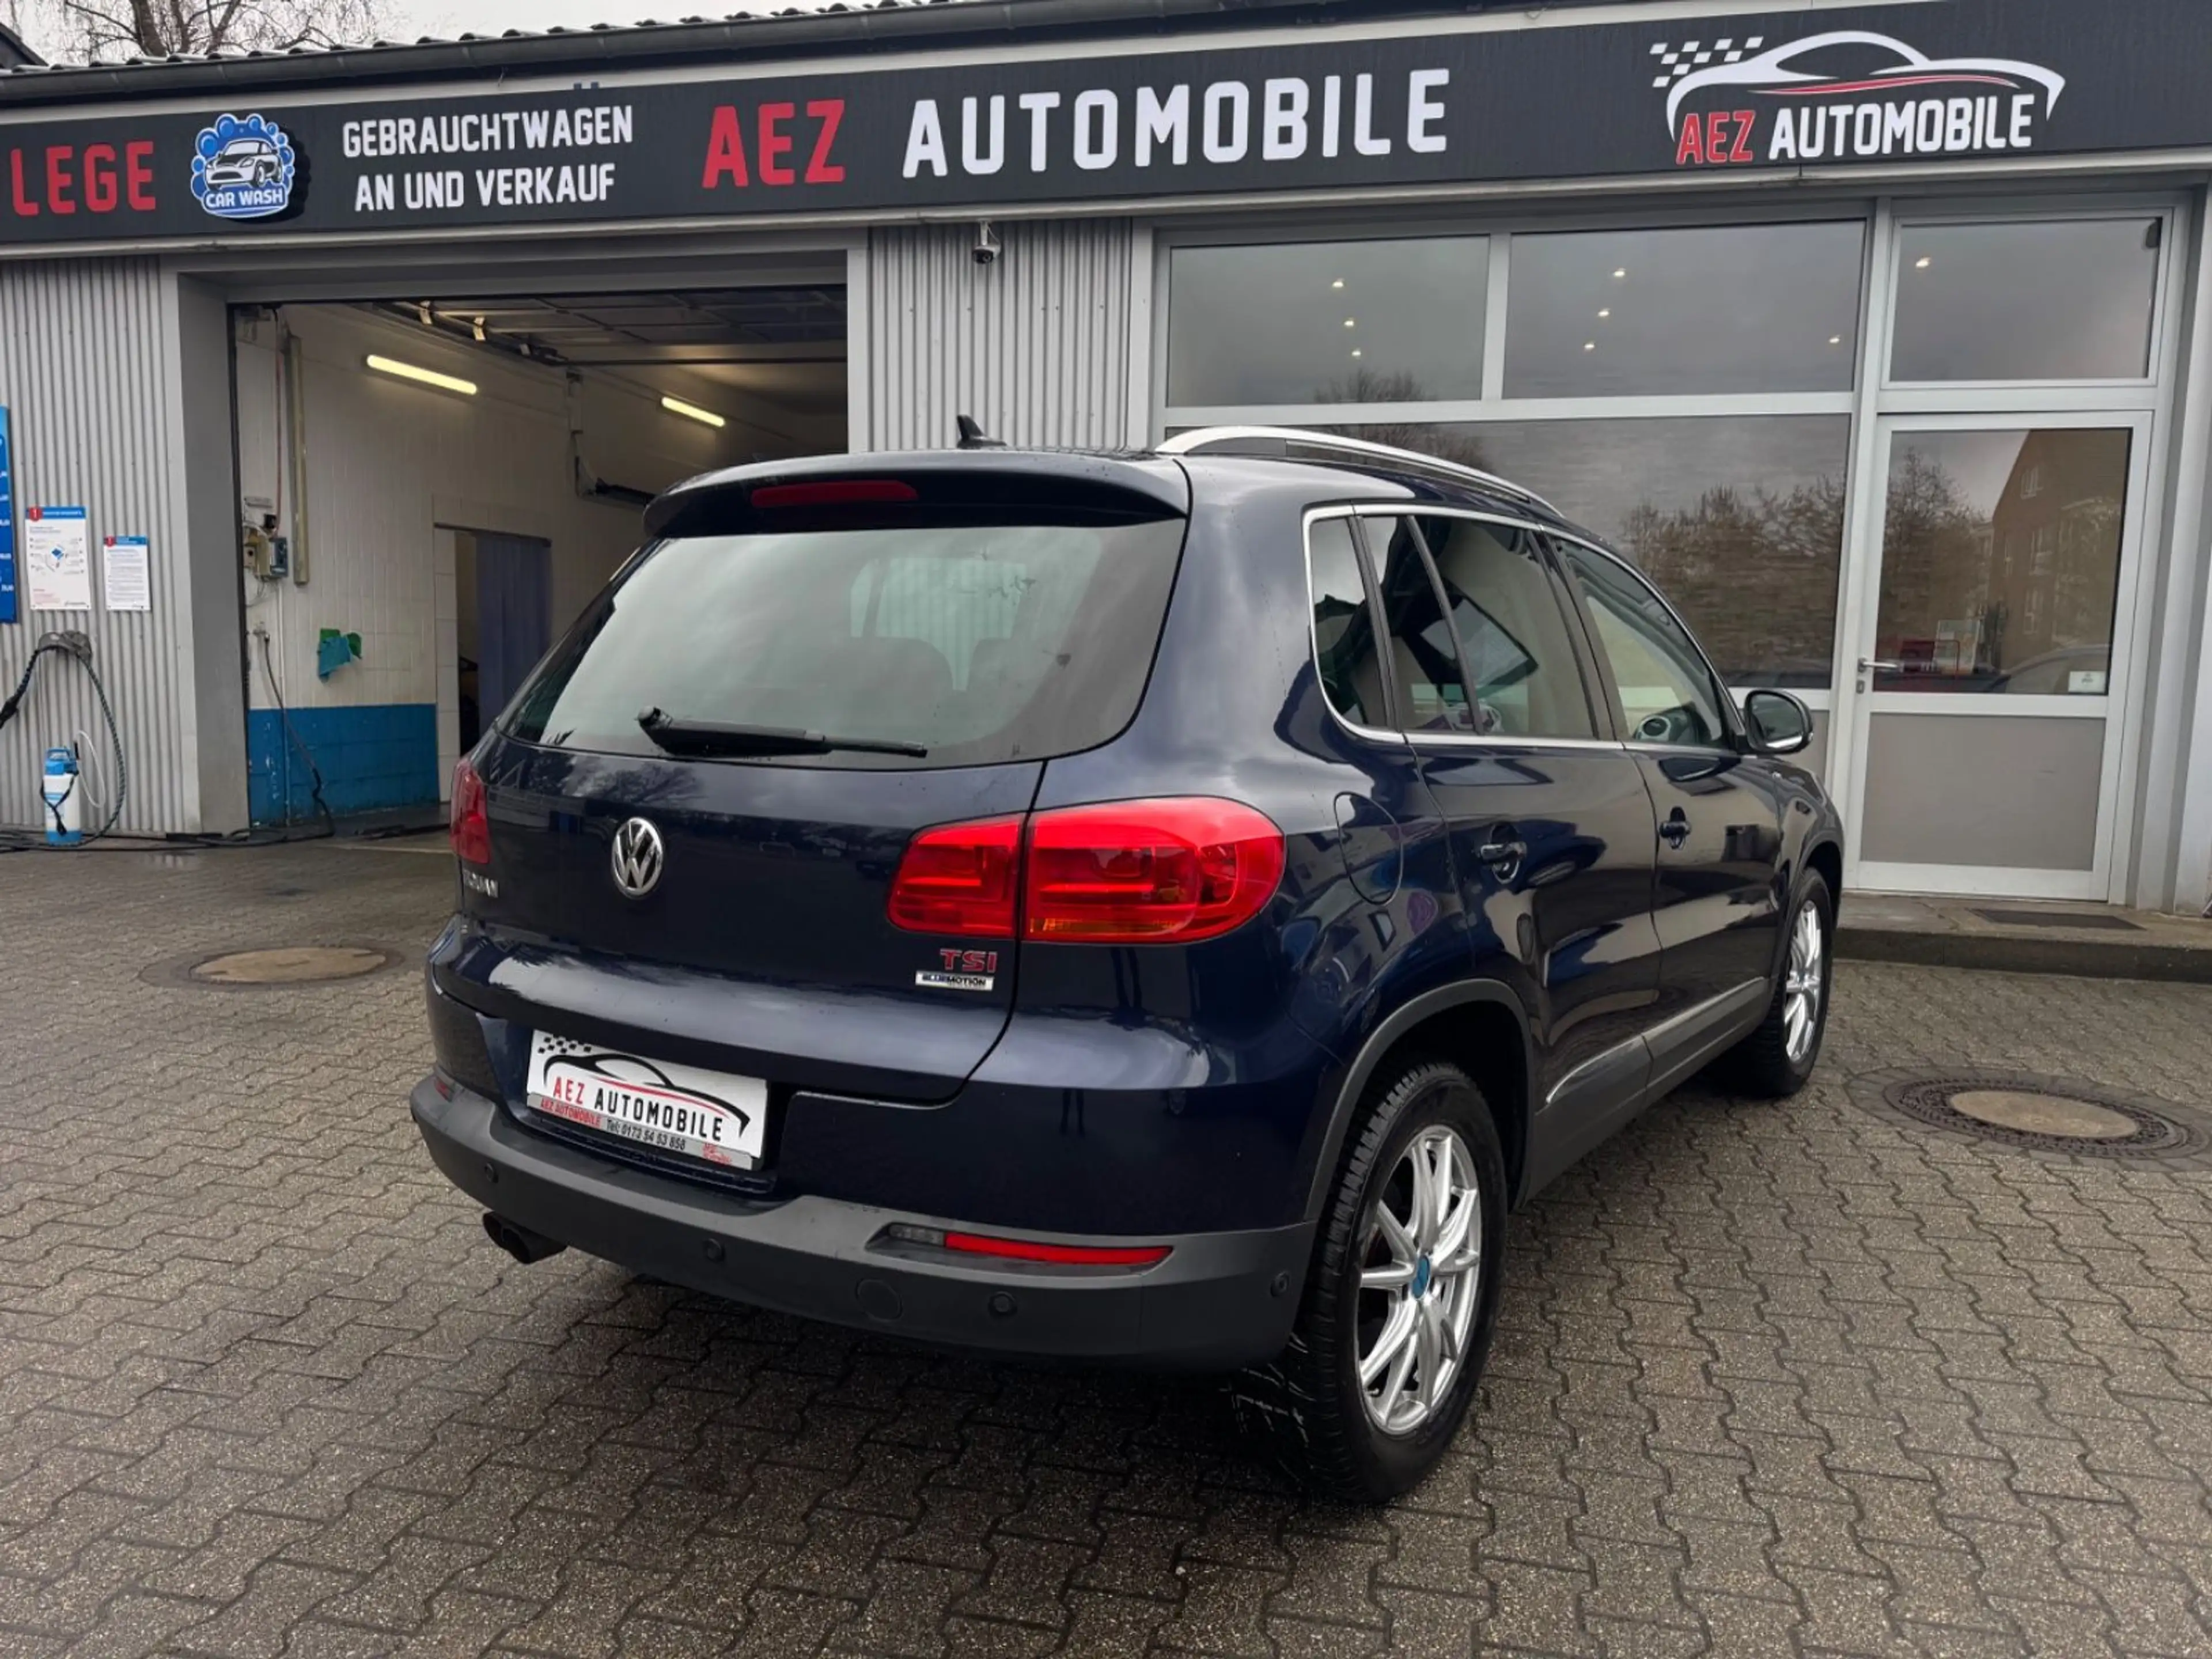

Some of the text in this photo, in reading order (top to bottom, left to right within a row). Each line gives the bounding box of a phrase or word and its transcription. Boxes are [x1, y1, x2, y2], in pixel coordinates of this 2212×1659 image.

[343, 105, 632, 158] GEBRAUCHTWAGEN
[702, 68, 1450, 189] AEZ AUTOMOBILE
[1676, 93, 2035, 165] AEZ AUTOMOBILE
[10, 141, 156, 216] LEGE
[206, 188, 283, 208] CAR WASH
[355, 162, 616, 211] AN UND VERKAUF
[940, 948, 998, 974] TSI
[552, 1076, 724, 1142] AEZ AUTOMOBILE
